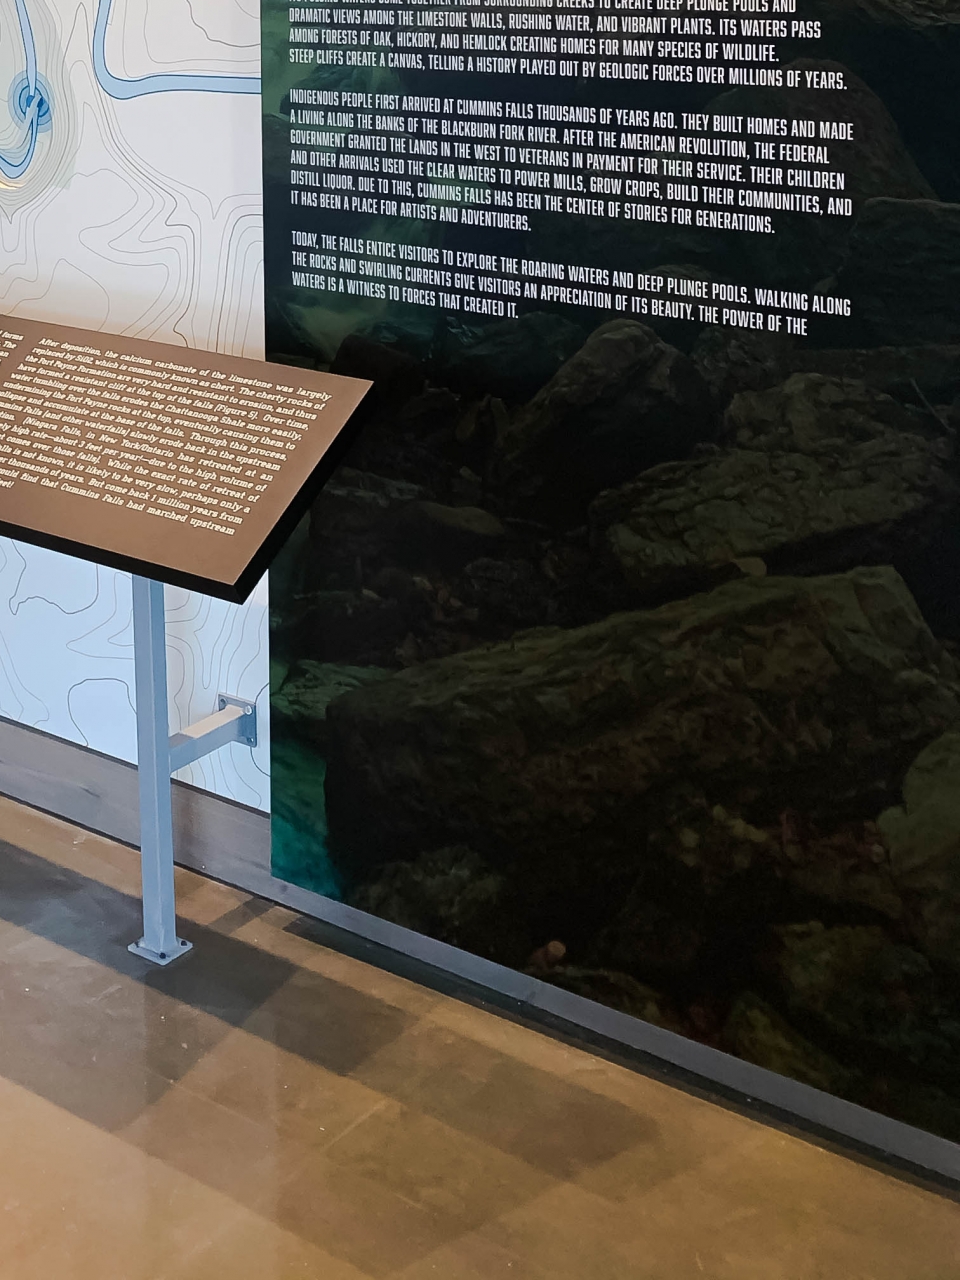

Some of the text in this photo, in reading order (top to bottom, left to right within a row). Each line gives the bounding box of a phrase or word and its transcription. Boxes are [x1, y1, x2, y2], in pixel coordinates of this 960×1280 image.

[289, 88, 854, 140] INDIGENOUS PEOPLE FIRST ARRIVED AT CUMMINS FALLS THOUSANDS OF YEARS AGO. THEY BUILT HOMES AND MADE
[291, 250, 807, 335] THE ROCKS AND SWIRLING CURRENTS GIVE VISITORS AN APPRECIATION OF ITS BEAUTY. THE POWER OF THE
[291, 271, 519, 318] WATERS IS A WITNESS TO FORCES THAT CREATED IT.
[38, 338, 60, 347] After
[60, 342, 101, 356] deposition,
[104, 350, 119, 358] the
[119, 354, 152, 365] calcium
[154, 361, 197, 374] carbonate
[211, 371, 226, 379] the
[227, 374, 273, 389] limestone
[275, 384, 294, 393] was
[296, 387, 332, 402] largely
[10, 372, 302, 441] water tumbling over the falls erodes the Chattanooga Shale more easily,
[26, 397, 44, 405] and
[42, 401, 90, 415] accumulate
[100, 412, 115, 421] the
[114, 415, 136, 425] base
[147, 422, 162, 432] the
[162, 426, 184, 437] falls.
[189, 431, 228, 447] Through
[229, 440, 248, 451] this
[247, 446, 287, 461] process,
